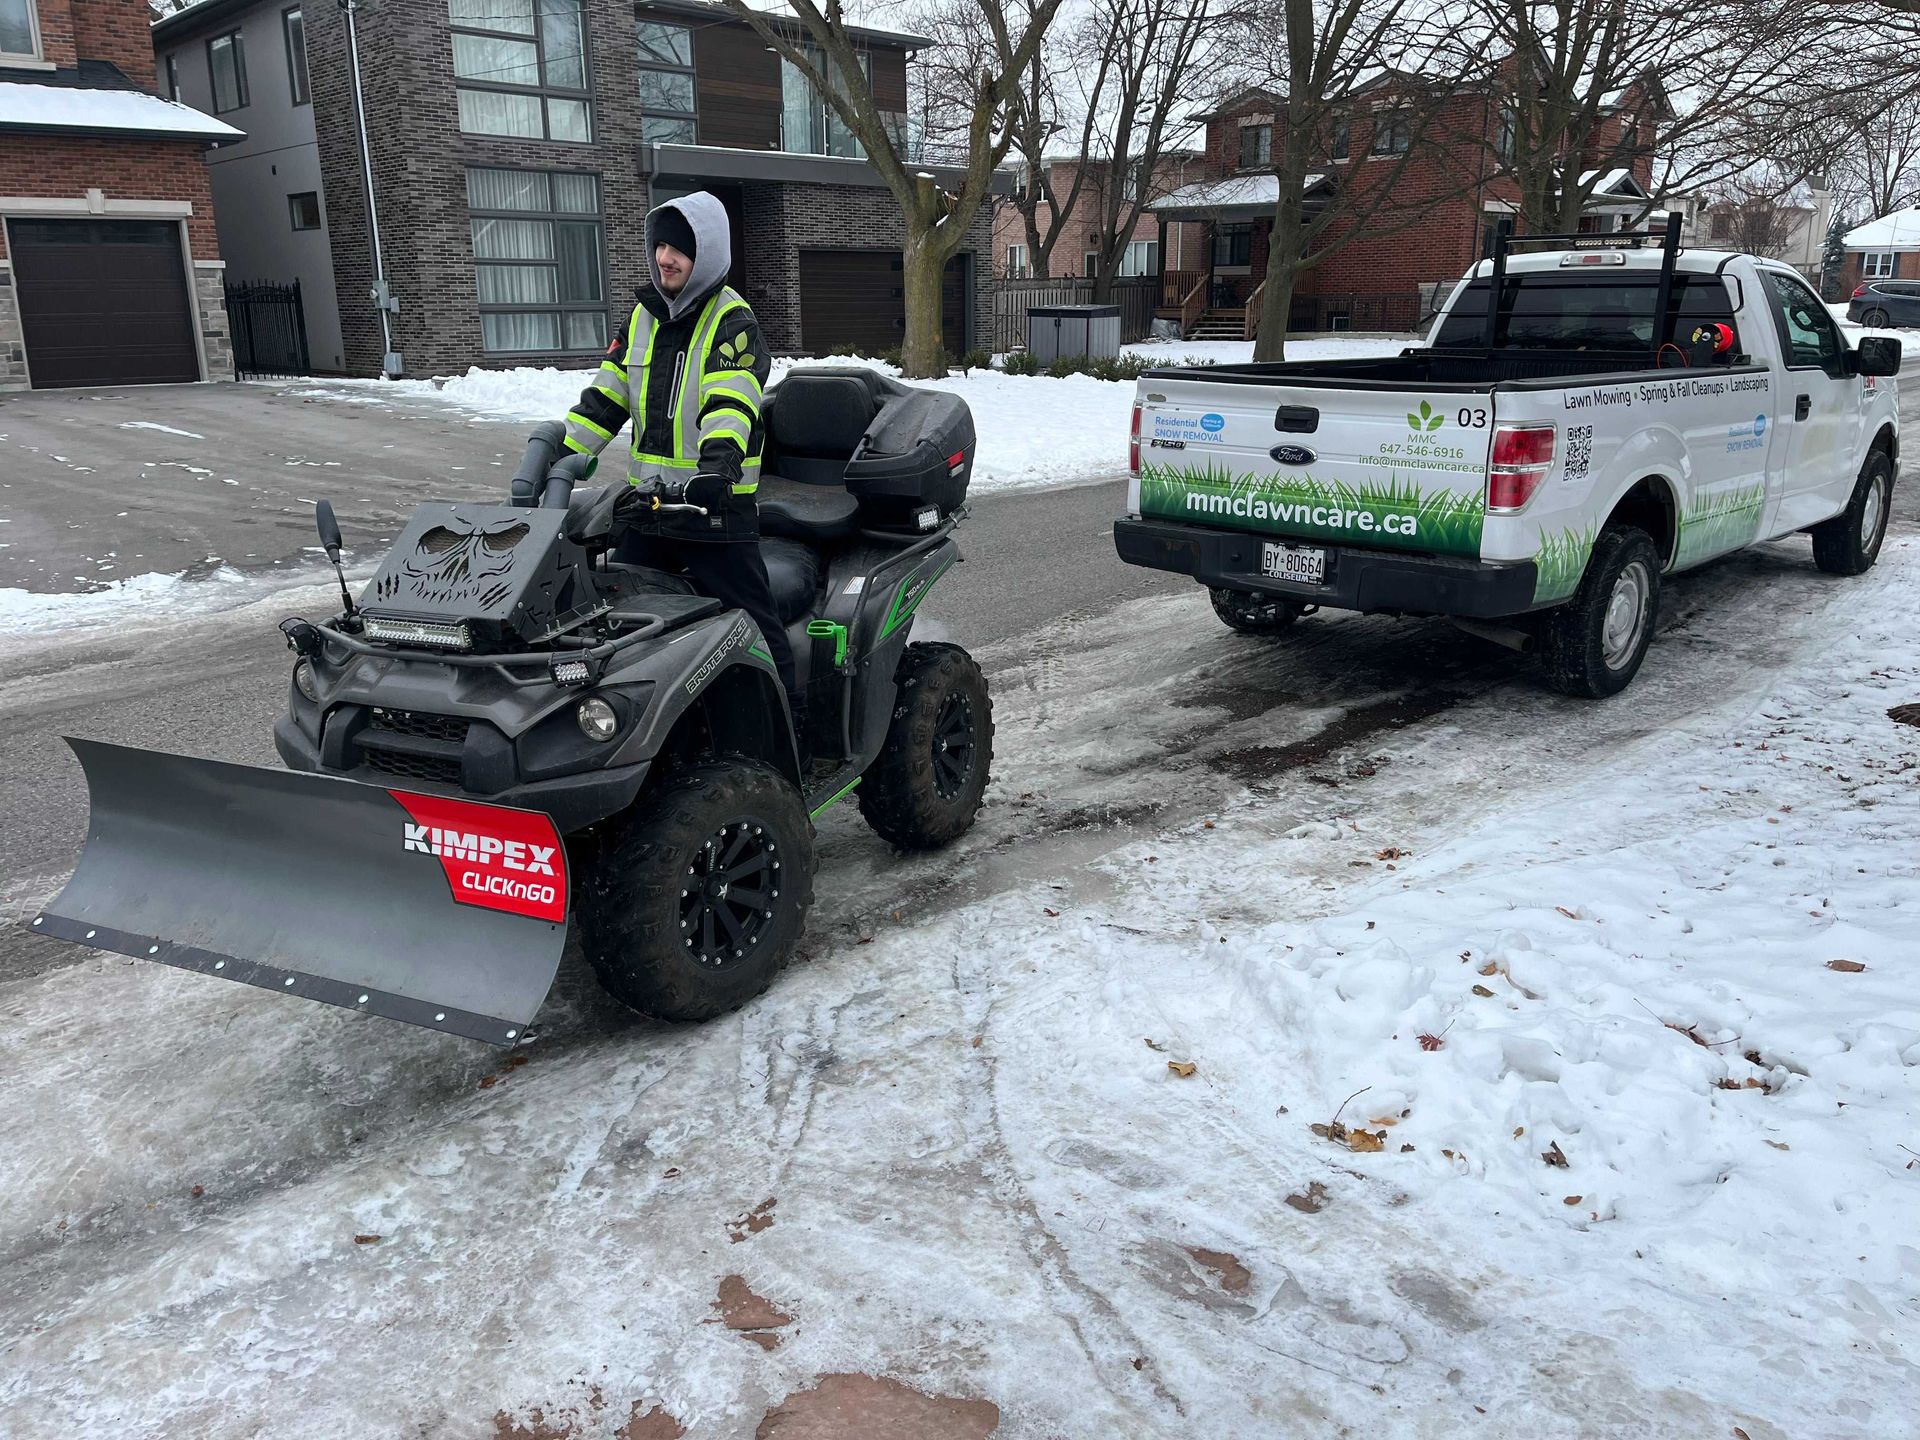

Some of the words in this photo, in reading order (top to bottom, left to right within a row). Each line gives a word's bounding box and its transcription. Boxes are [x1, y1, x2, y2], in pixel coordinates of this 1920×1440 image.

[1563, 392, 1592, 409] Lawn
[1593, 387, 1631, 407] Mowing
[1639, 384, 1668, 404] Spring
[1669, 382, 1676, 398] &
[1676, 381, 1690, 397] Fall
[1691, 380, 1724, 396] Cleanups
[1730, 375, 1768, 392] Landscaping
[1155, 416, 1198, 427] Residential
[1457, 407, 1487, 428] 03
[1154, 428, 1182, 438] SNOW
[1183, 431, 1224, 442] REMOVAL
[1407, 434, 1437, 444] MMC
[1277, 447, 1304, 461] Ford
[1379, 443, 1464, 458] 647-546-6916
[1359, 454, 1485, 473] info@mmclawncare.ca
[1186, 491, 1417, 536] mmclawncare.ca
[1265, 550, 1280, 570] BY
[1286, 553, 1322, 576] 80664
[1268, 570, 1309, 583] COLISEUM
[404, 822, 556, 876] KIMPEX
[462, 871, 555, 904] CLICKnGO
